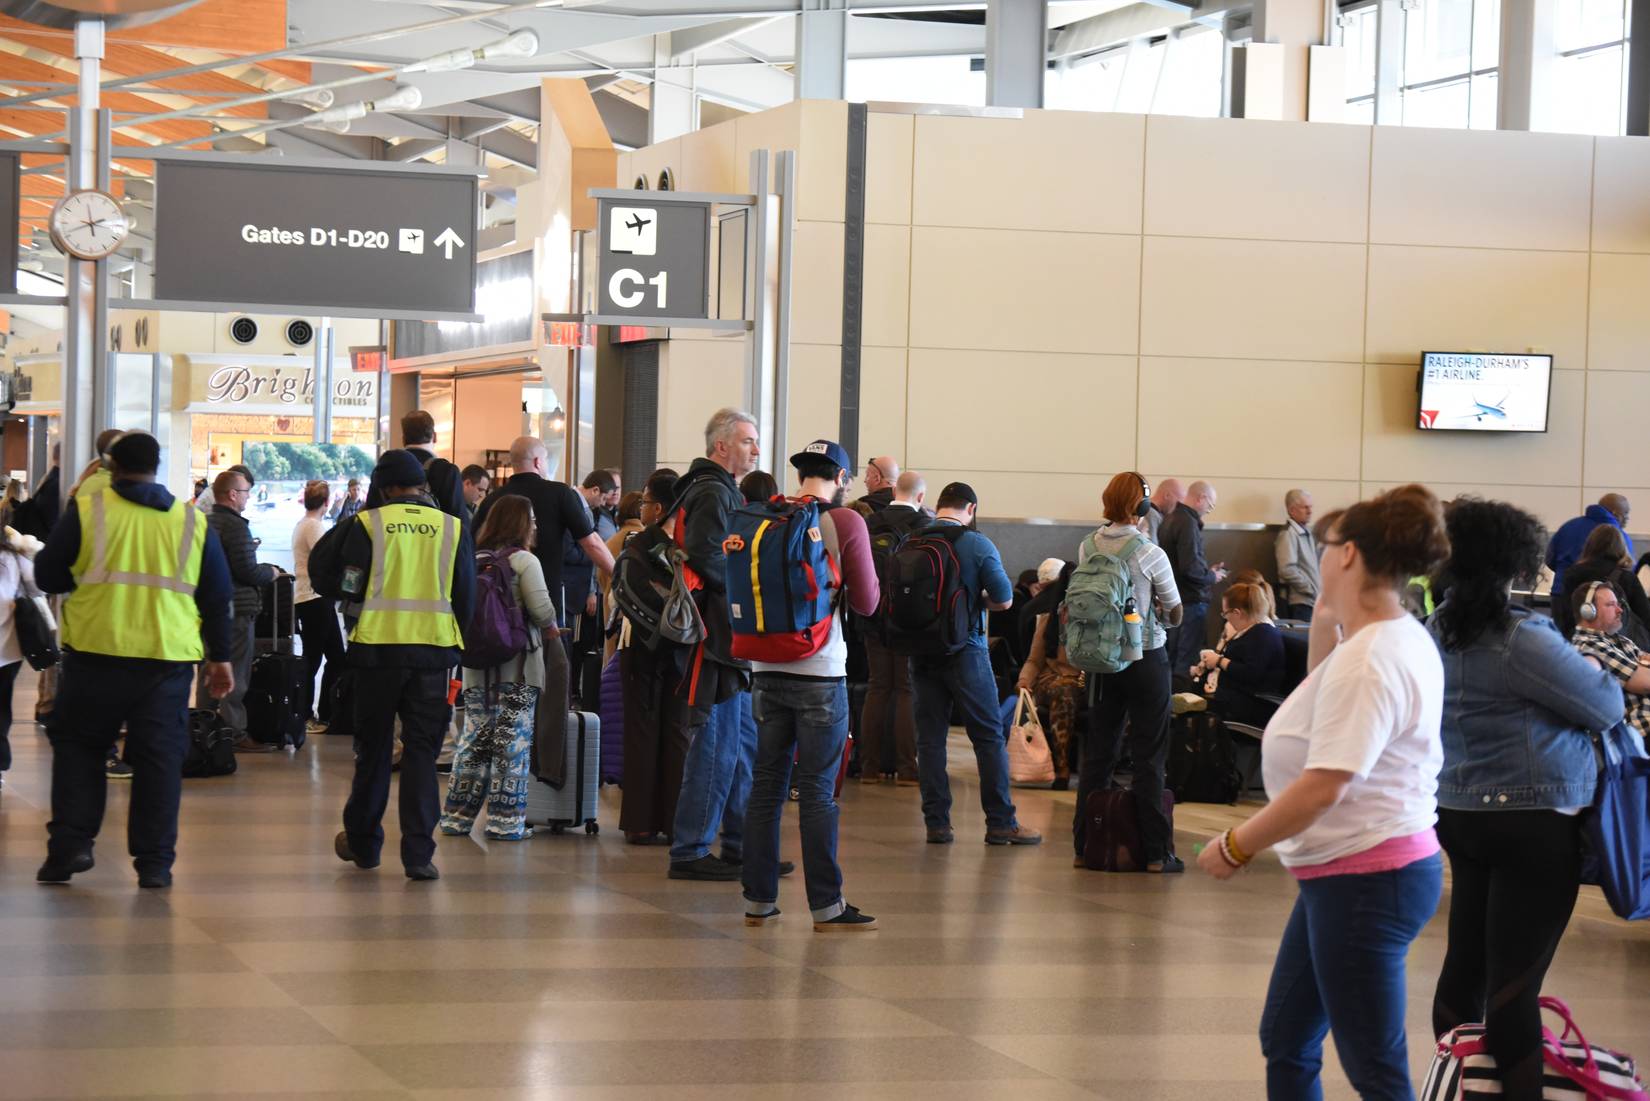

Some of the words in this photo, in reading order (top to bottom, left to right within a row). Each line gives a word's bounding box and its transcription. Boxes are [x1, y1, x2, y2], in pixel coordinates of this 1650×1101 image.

[241, 224, 305, 245] Gates
[310, 227, 389, 249] D1-D20
[608, 268, 667, 308] C1
[1428, 356, 1529, 369] RALEIGH-DURHAM'S
[208, 366, 373, 402] Brighon
[385, 523, 440, 538] envoy
